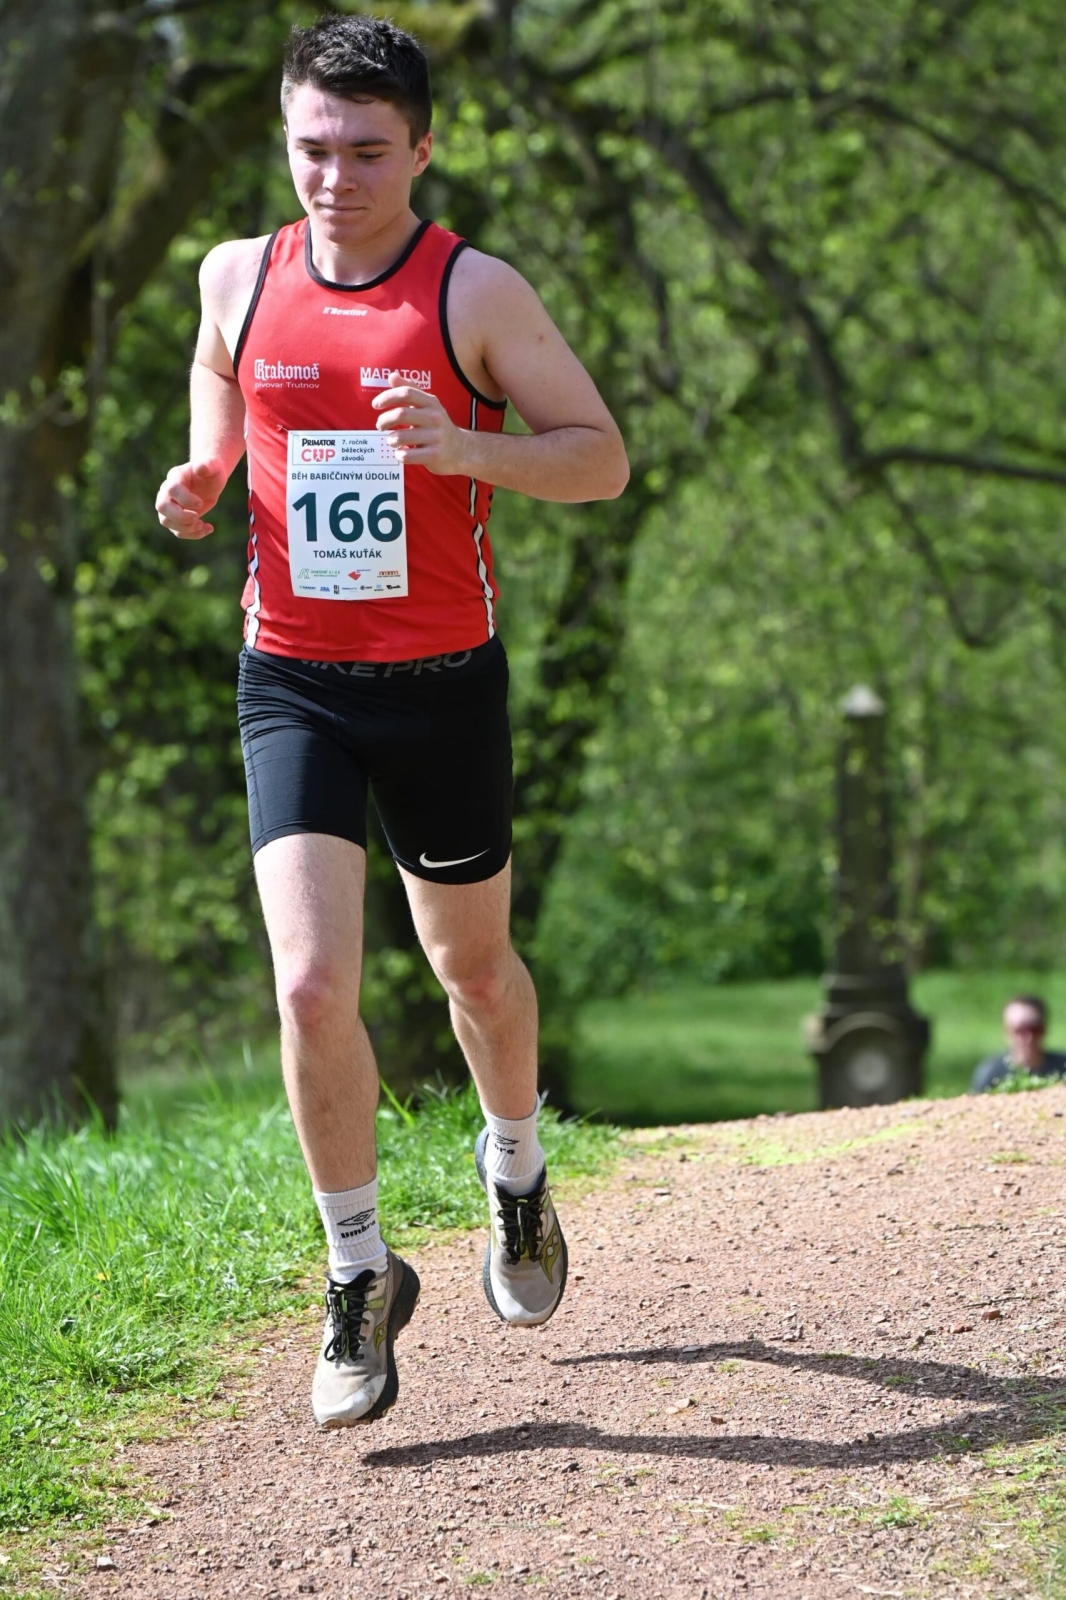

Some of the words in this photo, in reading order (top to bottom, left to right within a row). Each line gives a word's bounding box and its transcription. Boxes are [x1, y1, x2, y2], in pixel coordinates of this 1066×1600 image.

[254, 359, 320, 380] Krakonoš
[301, 448, 336, 462] CUP
[291, 471, 308, 480] BĚH
[310, 471, 363, 481] BABIČČINÝM
[365, 471, 400, 481] ÚDOLÍM
[292, 492, 403, 542] 166
[313, 548, 347, 559] TOMÁŠ
[349, 548, 382, 559] KUŤÁK
[301, 660, 376, 678] KE
[383, 649, 472, 678] PRO
